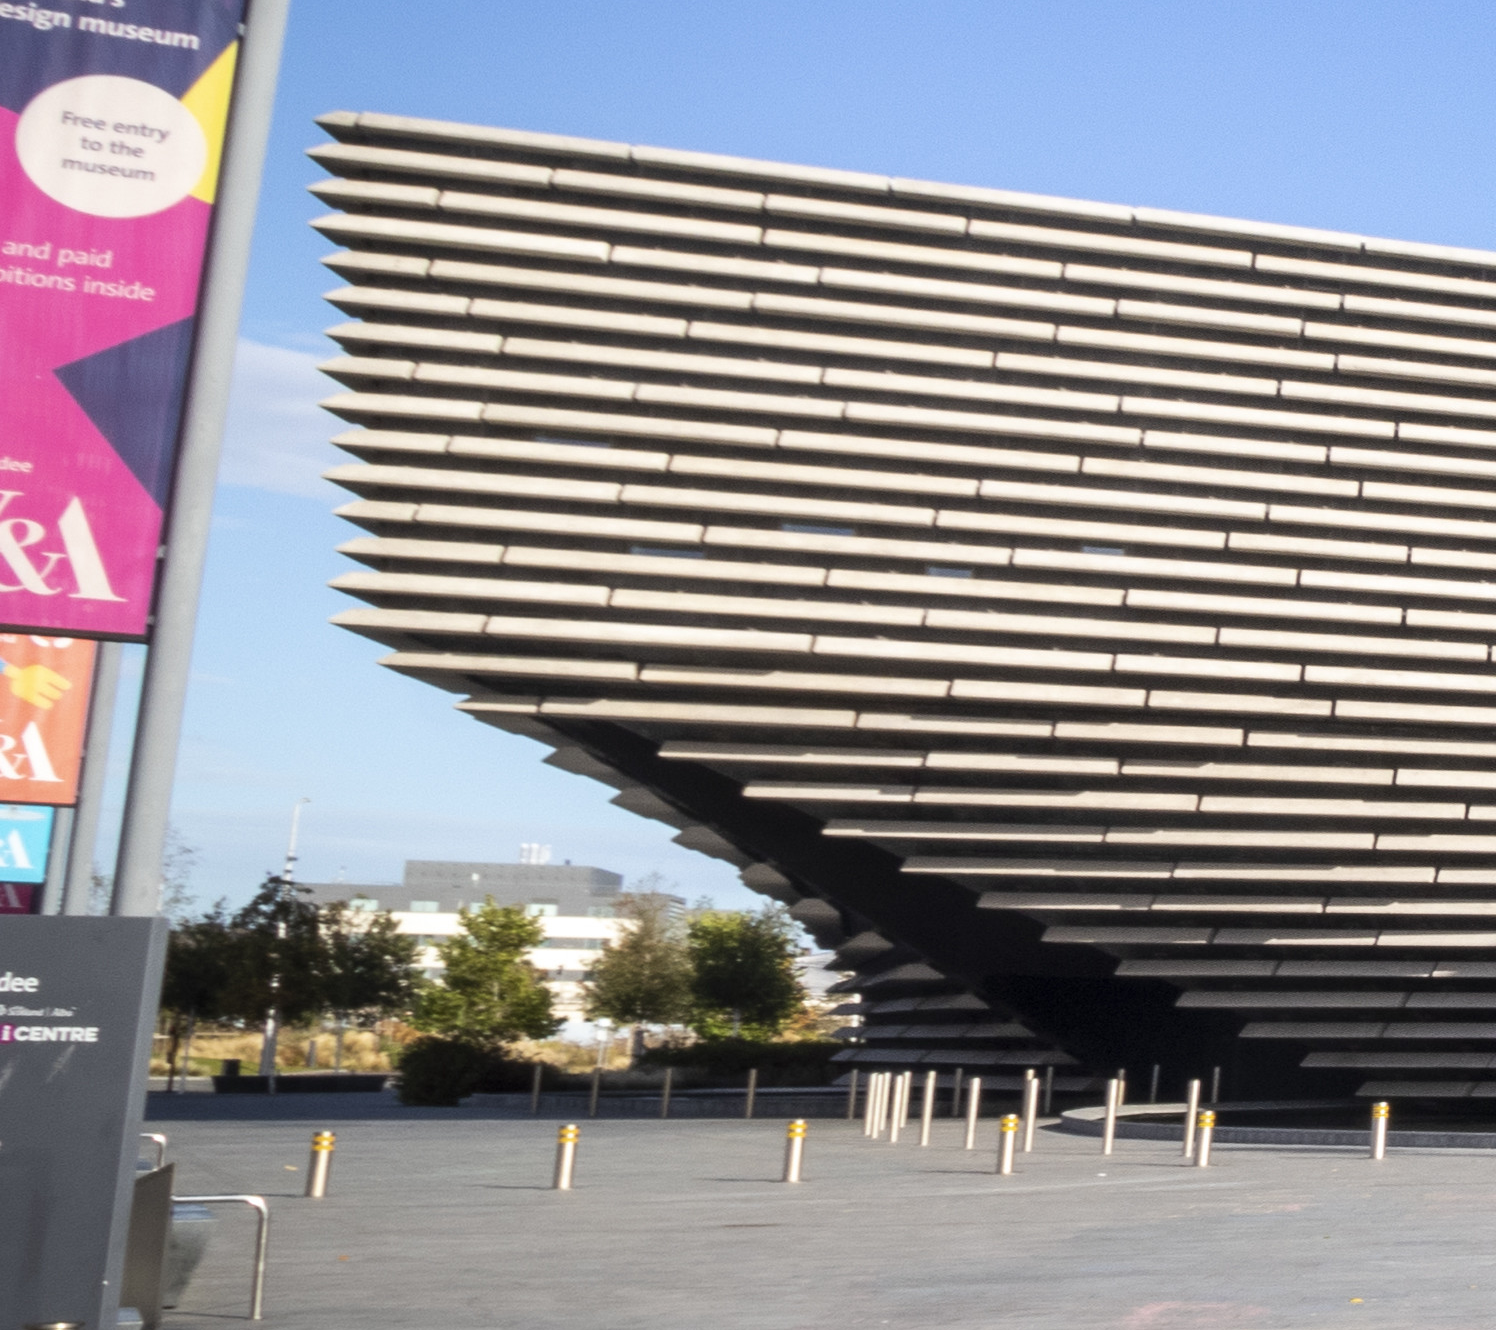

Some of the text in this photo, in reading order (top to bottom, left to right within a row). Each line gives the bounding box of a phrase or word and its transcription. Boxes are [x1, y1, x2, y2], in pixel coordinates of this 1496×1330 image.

[0, 2, 200, 50] esign museum
[61, 111, 170, 143] Free entry
[81, 137, 145, 158] to the
[61, 158, 156, 181] museum
[2, 241, 113, 268] and paid
[83, 276, 156, 301] inside
